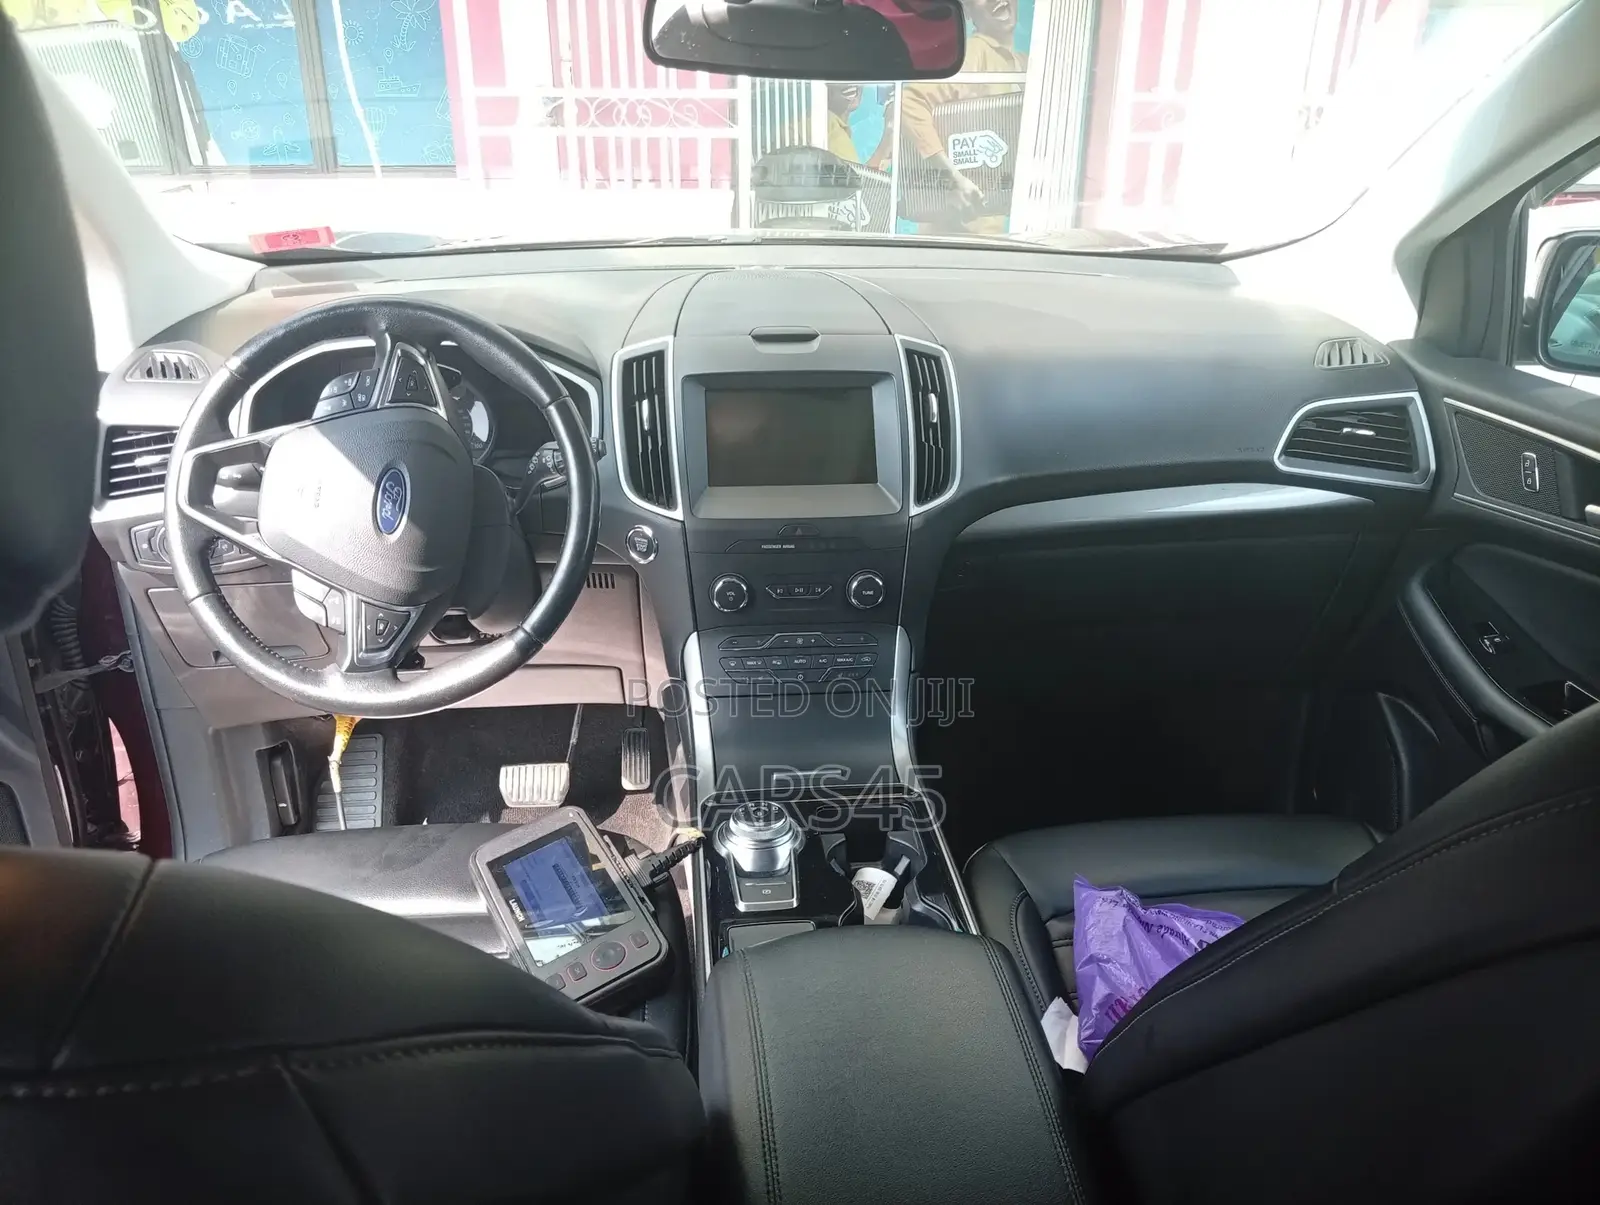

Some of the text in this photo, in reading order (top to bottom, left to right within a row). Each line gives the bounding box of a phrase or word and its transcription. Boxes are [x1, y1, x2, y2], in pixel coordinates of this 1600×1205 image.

[952, 136, 977, 150] PAY
[953, 149, 979, 158] SMALL
[953, 156, 979, 166] SMALL
[382, 481, 403, 521] Ford
[509, 898, 524, 922] LAUNCH
